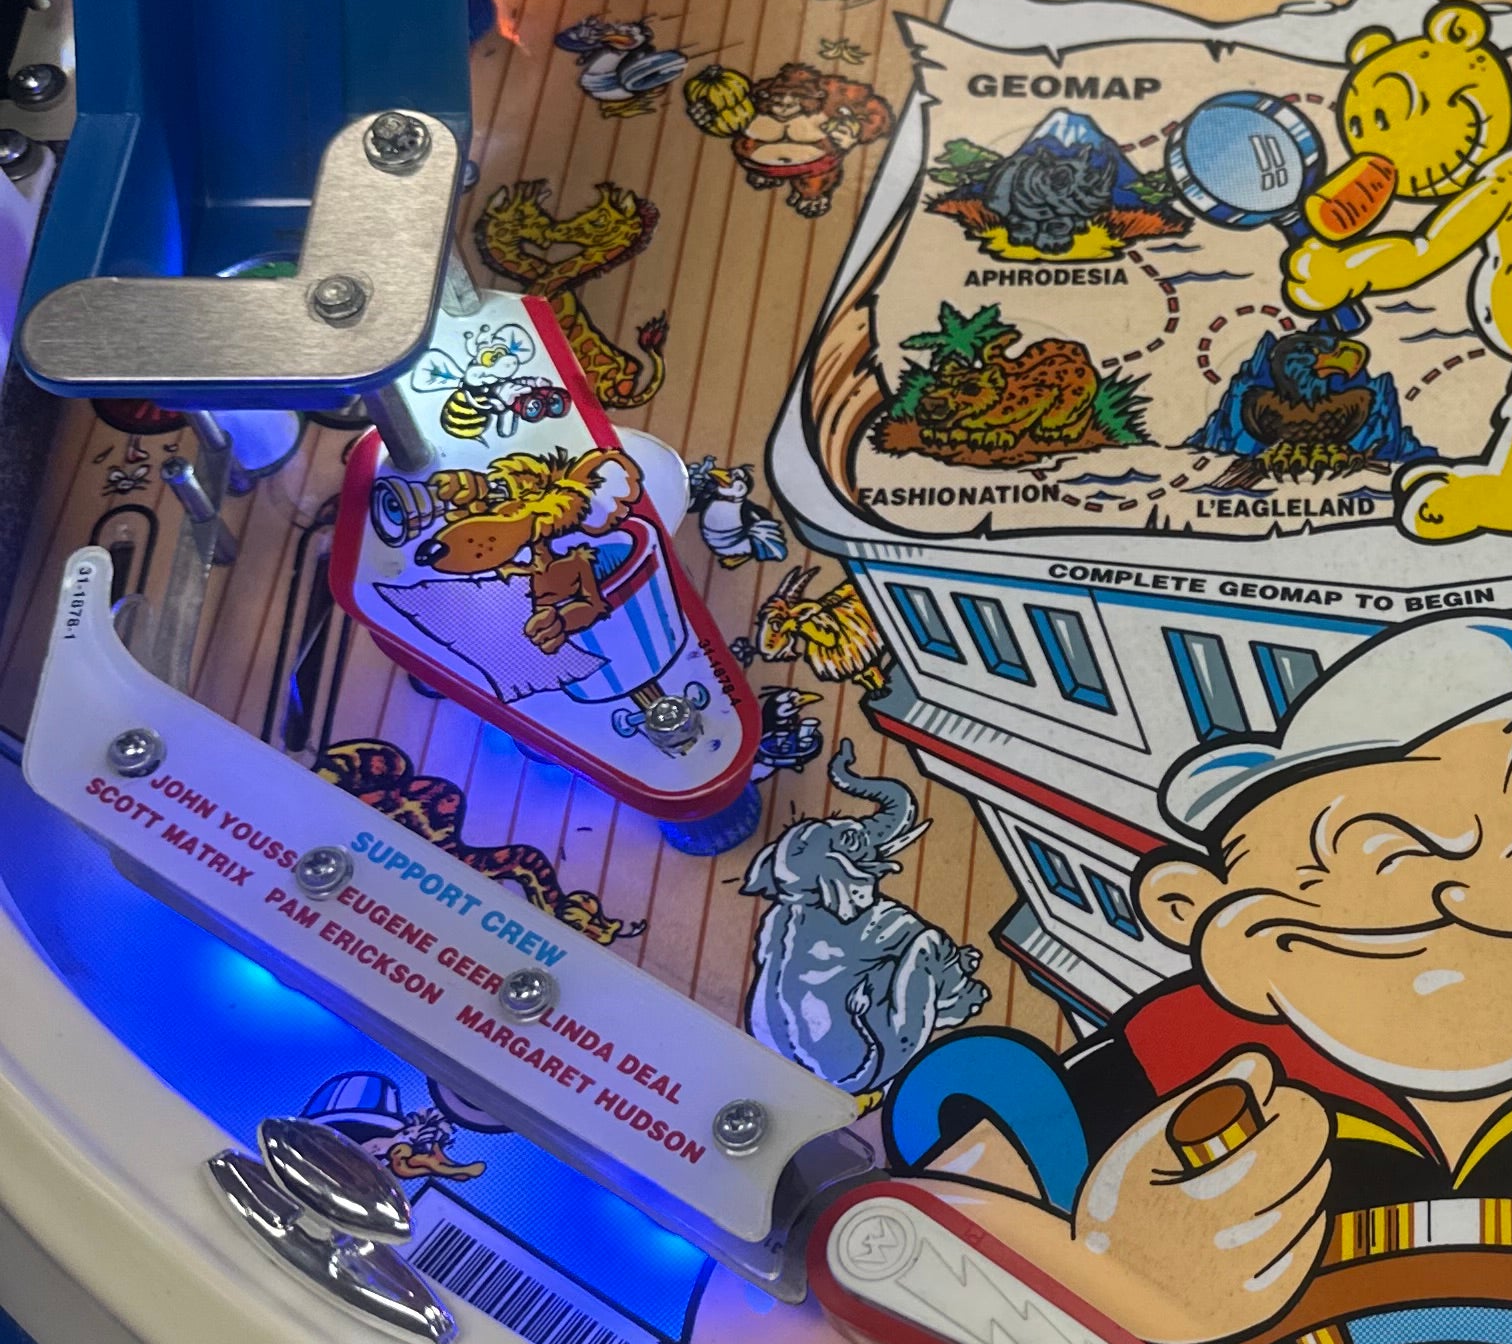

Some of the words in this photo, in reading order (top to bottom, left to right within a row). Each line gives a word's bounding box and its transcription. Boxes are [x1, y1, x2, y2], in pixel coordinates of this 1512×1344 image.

[967, 73, 1163, 101] GEOMAP
[963, 267, 1130, 288] APHRODESIA
[857, 482, 1061, 508] FASHIONATION
[1196, 496, 1377, 519] L'EAGLELAND
[1047, 562, 1208, 595] COMPLETE
[1218, 580, 1344, 607] GEOMAP
[1354, 592, 1395, 613] TO
[1404, 587, 1496, 614] BEGIN
[350, 830, 483, 917] SUPPORT
[480, 909, 569, 968] CREW
[150, 774, 220, 820] JOHN
[335, 885, 440, 955] EUGENE
[537, 1006, 616, 1064] LINDA
[616, 1052, 686, 1106] DEAL
[85, 776, 165, 830] SCOTT
[160, 822, 255, 888] MATRIX
[264, 887, 322, 930] PAM
[317, 919, 446, 1005] ERICKSON
[455, 1004, 597, 1096] MARGARET
[593, 1087, 707, 1165] HUDSON
